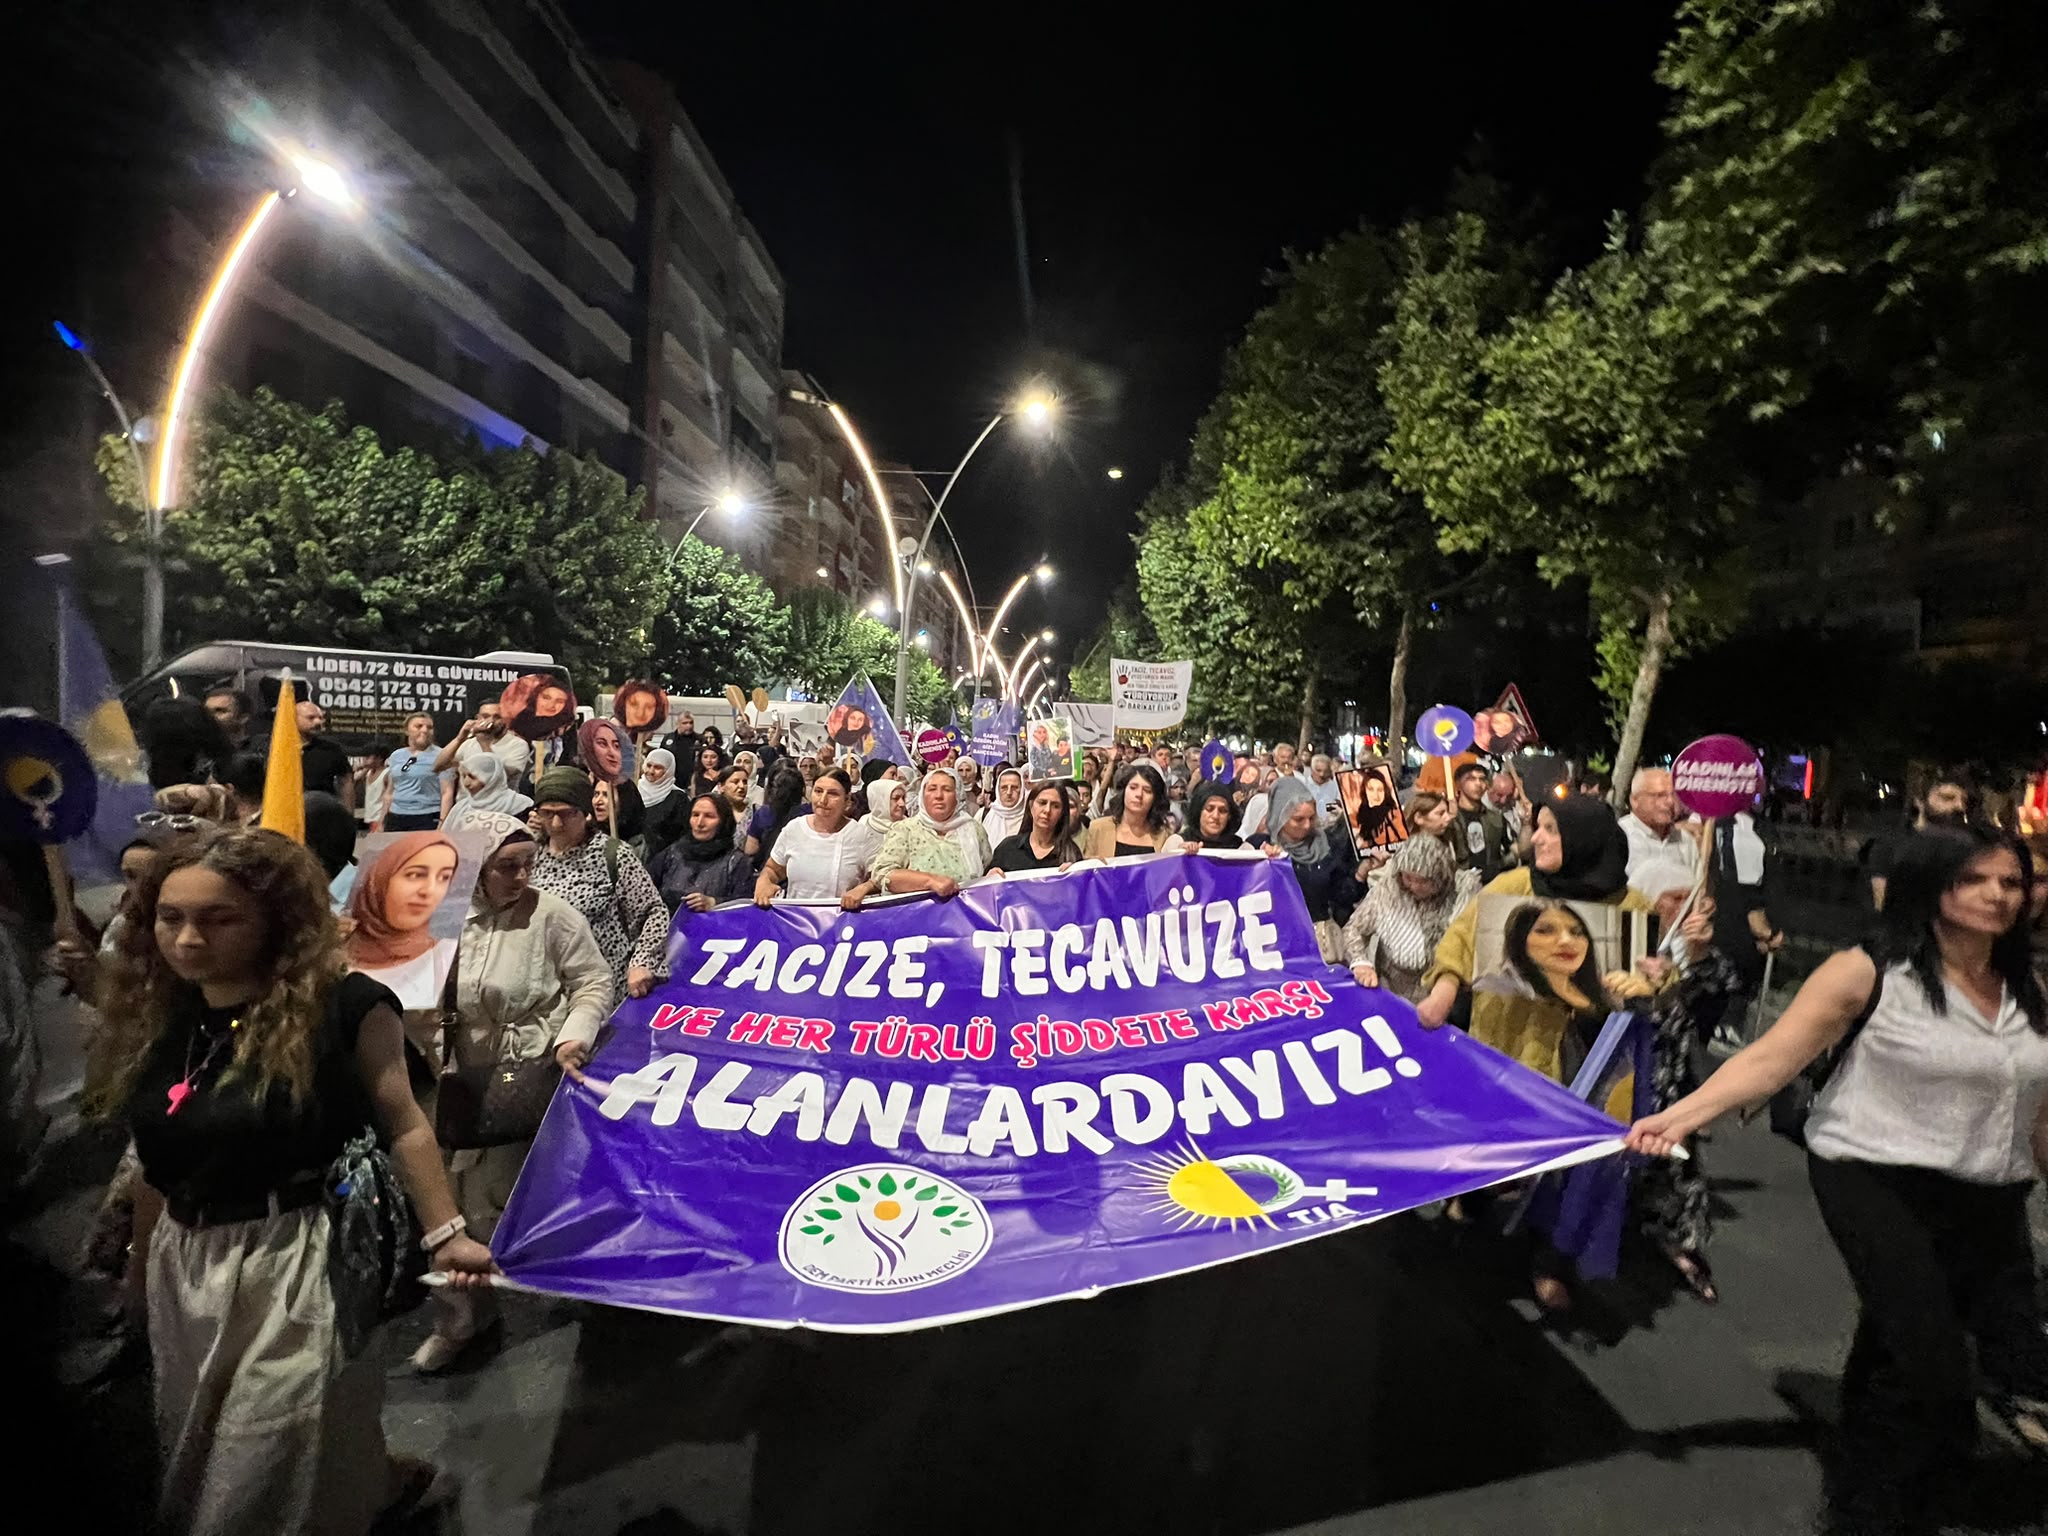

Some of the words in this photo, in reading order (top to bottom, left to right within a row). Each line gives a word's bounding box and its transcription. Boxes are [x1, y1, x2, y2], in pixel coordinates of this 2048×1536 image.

[393, 661, 434, 678] ÖZEL
[437, 665, 519, 682] GÜVENLİK
[319, 677, 375, 694] 0542
[379, 680, 412, 696] 172
[445, 684, 467, 698] 72
[318, 693, 376, 709] 0488
[380, 695, 417, 711] 215
[420, 697, 440, 712] 71
[443, 698, 463, 713] 71
[1676, 760, 1758, 777] KADINLAR
[689, 926, 946, 1008] TACİZE,
[972, 885, 1284, 998] TECAVÜZE
[649, 1003, 725, 1037] VE
[726, 1011, 836, 1053] HER
[850, 1016, 997, 1063] TÜRLÜ
[1010, 1009, 1199, 1068] ŞİDDETE
[1201, 980, 1333, 1031] KARŞI
[599, 1015, 1422, 1157] ALANLARDAYIZ!
[802, 1263, 830, 1280] DEM
[829, 1274, 873, 1287] PARTİ
[875, 1274, 925, 1287] KADIN
[924, 1249, 973, 1277] MECLİSİ
